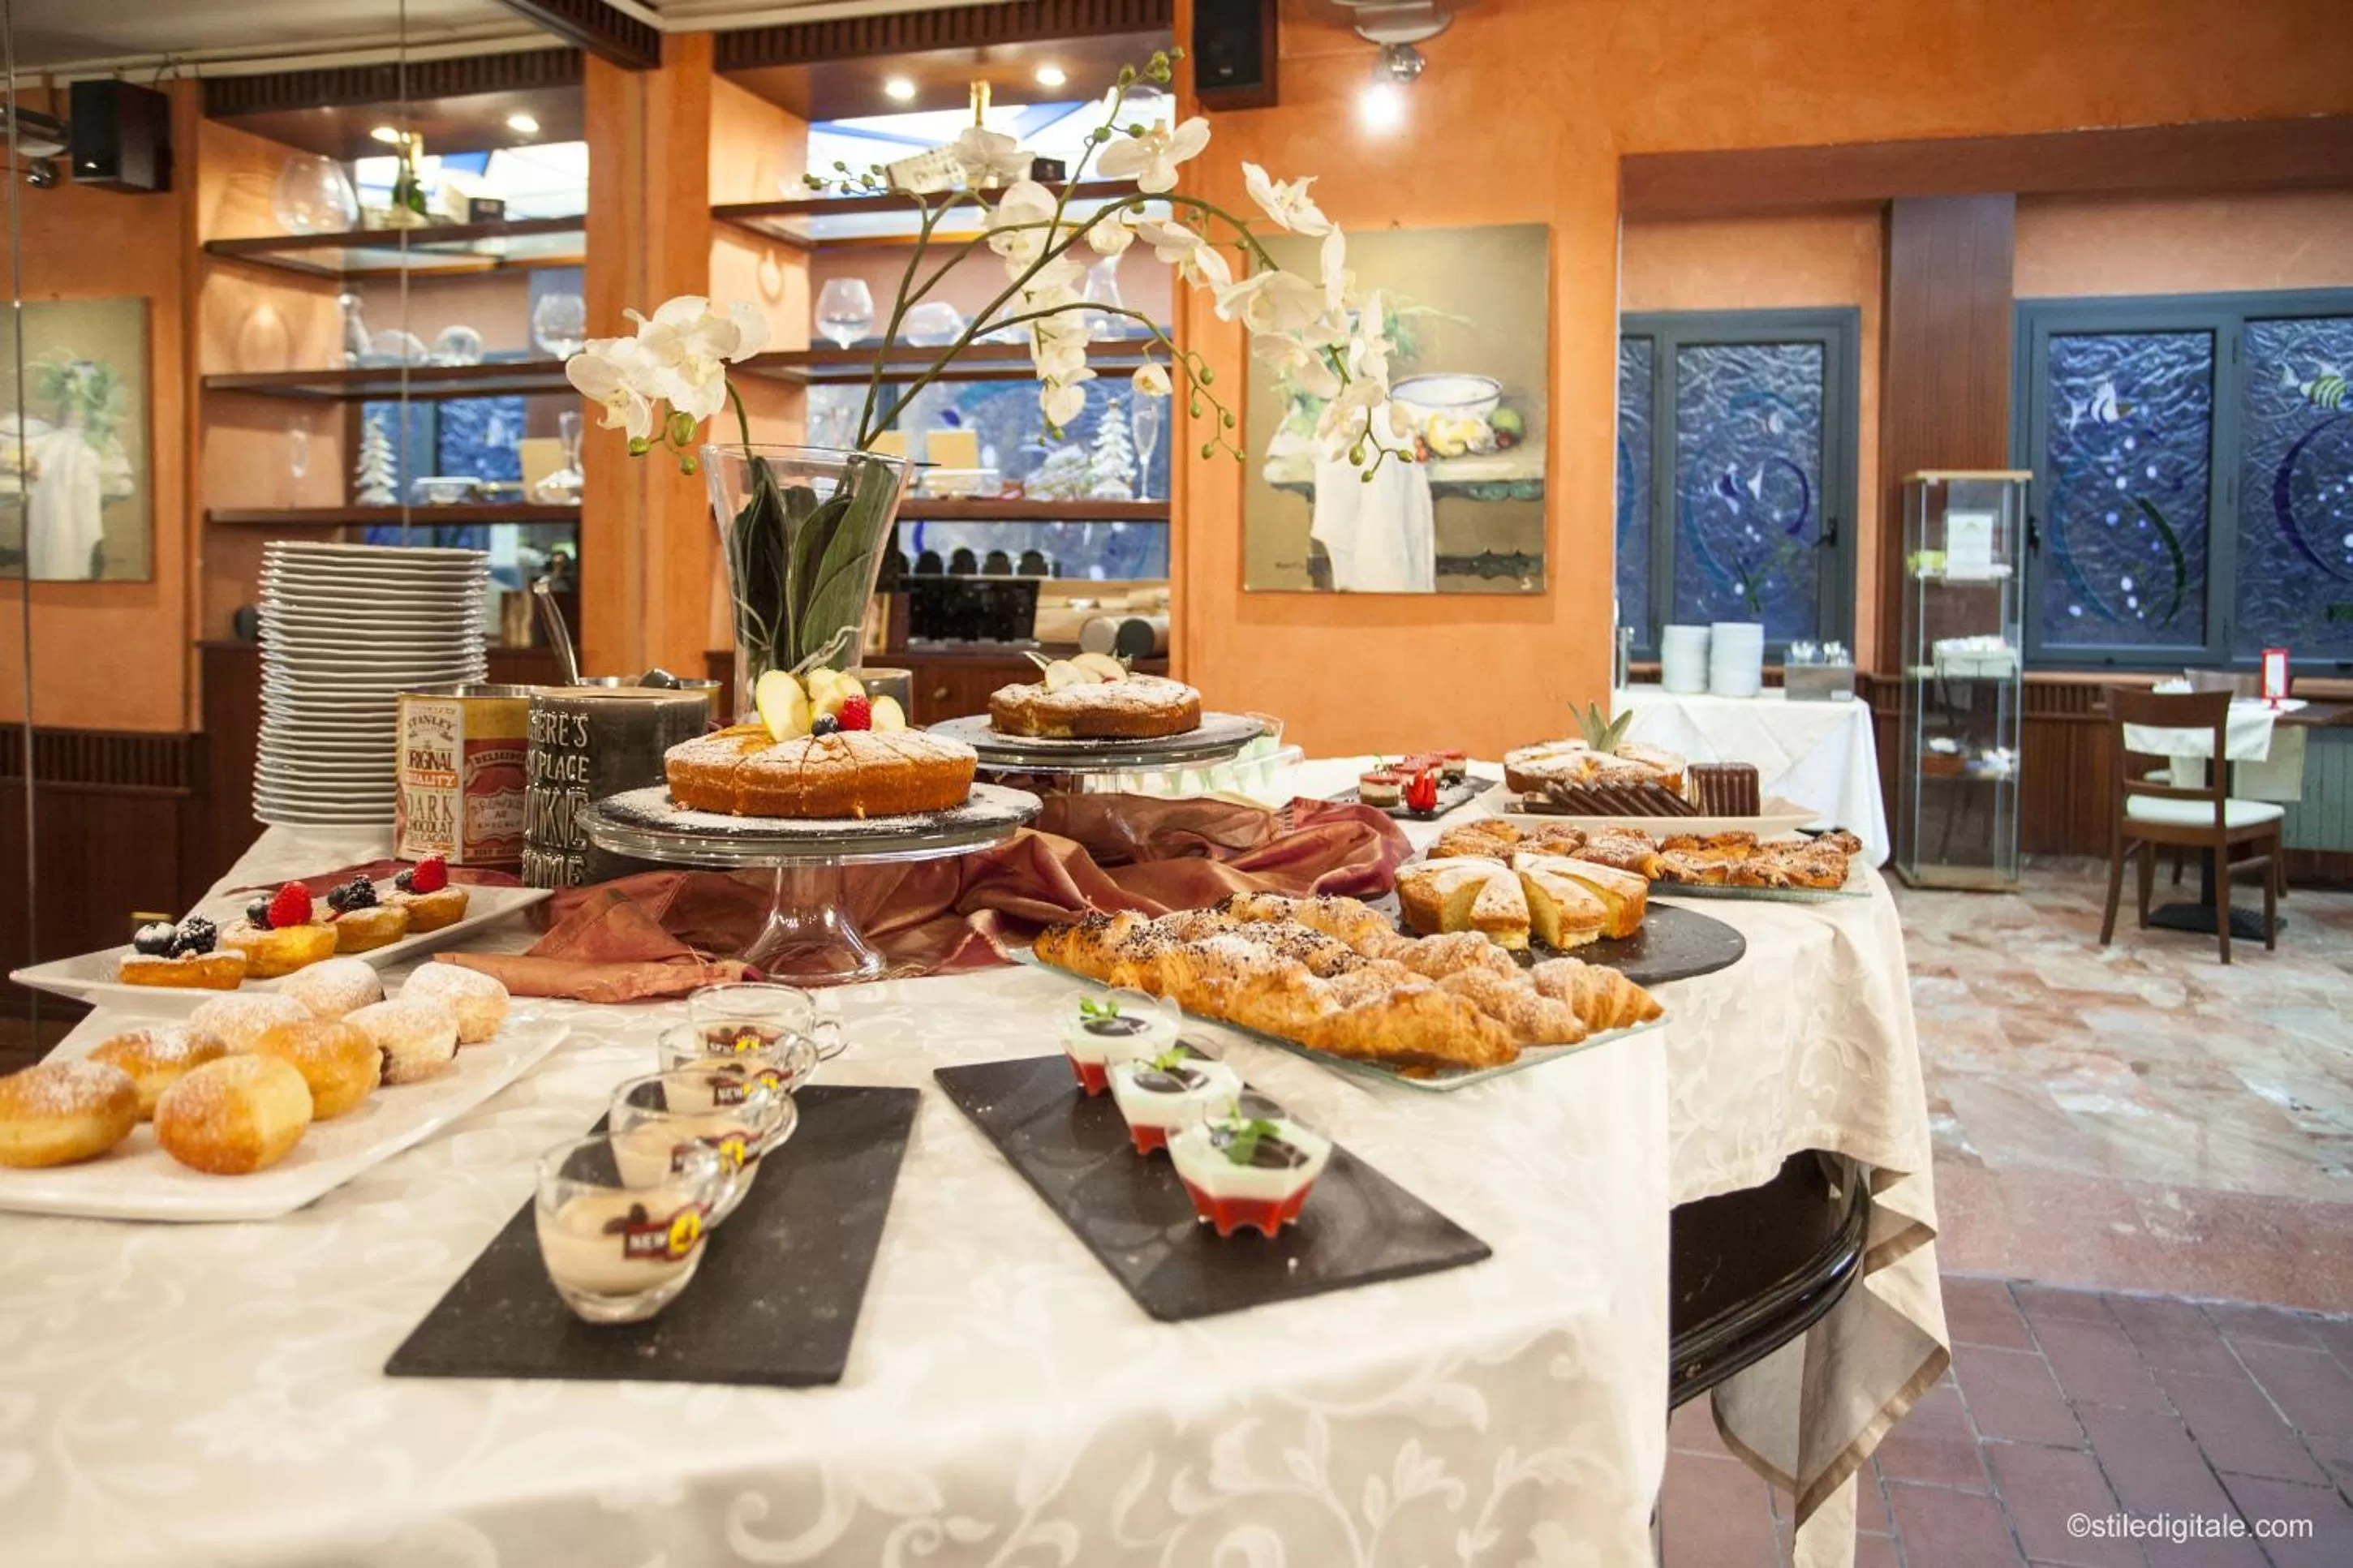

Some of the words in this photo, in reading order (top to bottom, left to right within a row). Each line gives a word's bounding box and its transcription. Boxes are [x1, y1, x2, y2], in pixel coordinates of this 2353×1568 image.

[539, 750, 590, 783] PLACE
[717, 1086, 745, 1101] NEW
[629, 1231, 669, 1250] NEW
